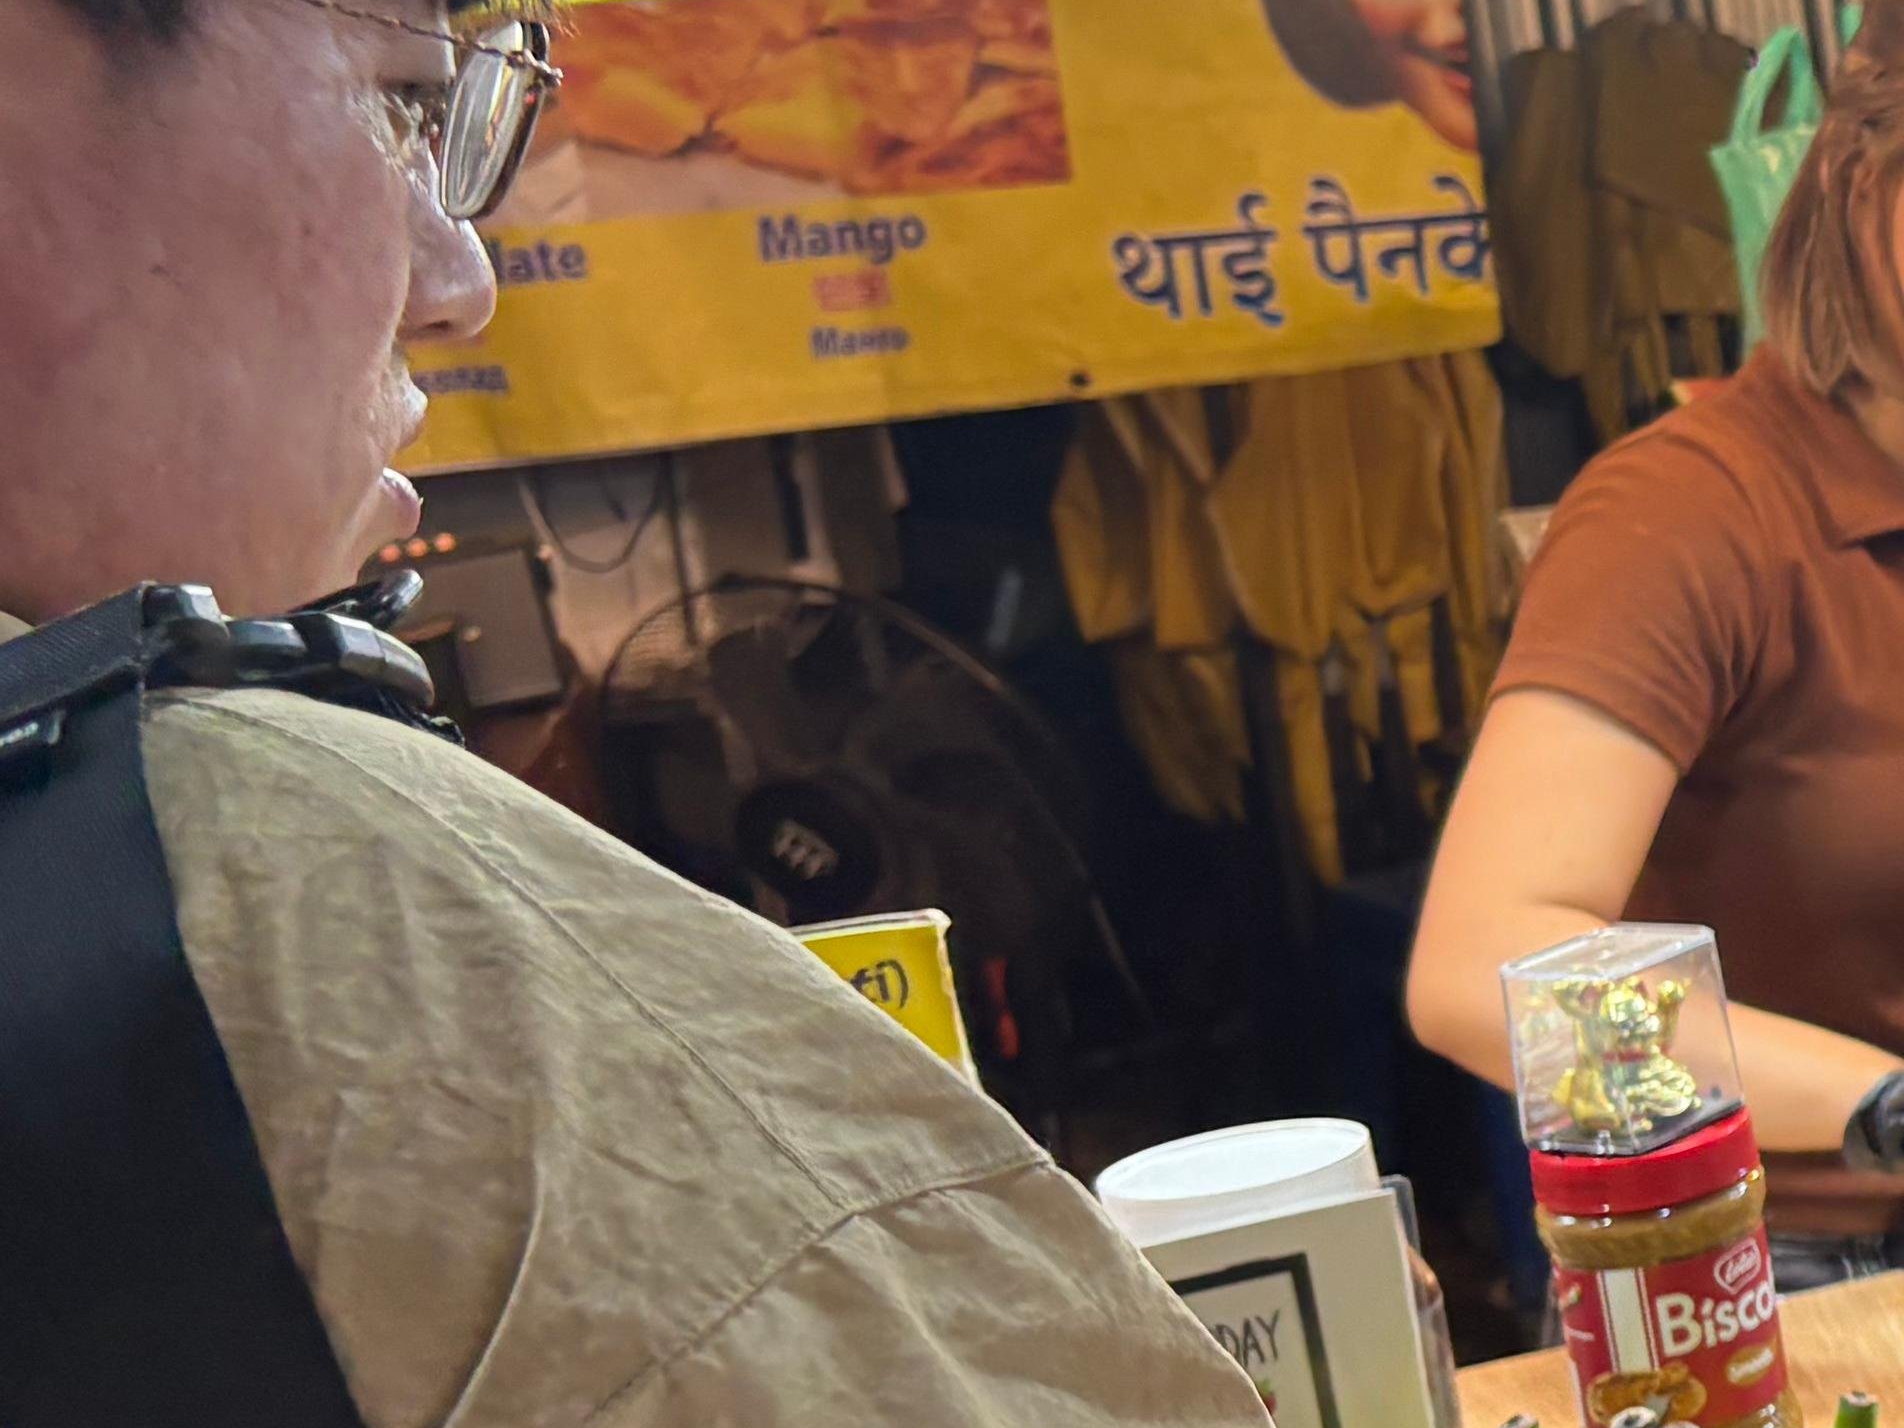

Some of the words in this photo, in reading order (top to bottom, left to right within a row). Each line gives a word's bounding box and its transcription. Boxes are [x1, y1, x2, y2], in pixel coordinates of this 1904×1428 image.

[757, 213, 927, 264] Mango
[1111, 192, 1285, 328] थाई
[1213, 1309, 1281, 1369] DAY
